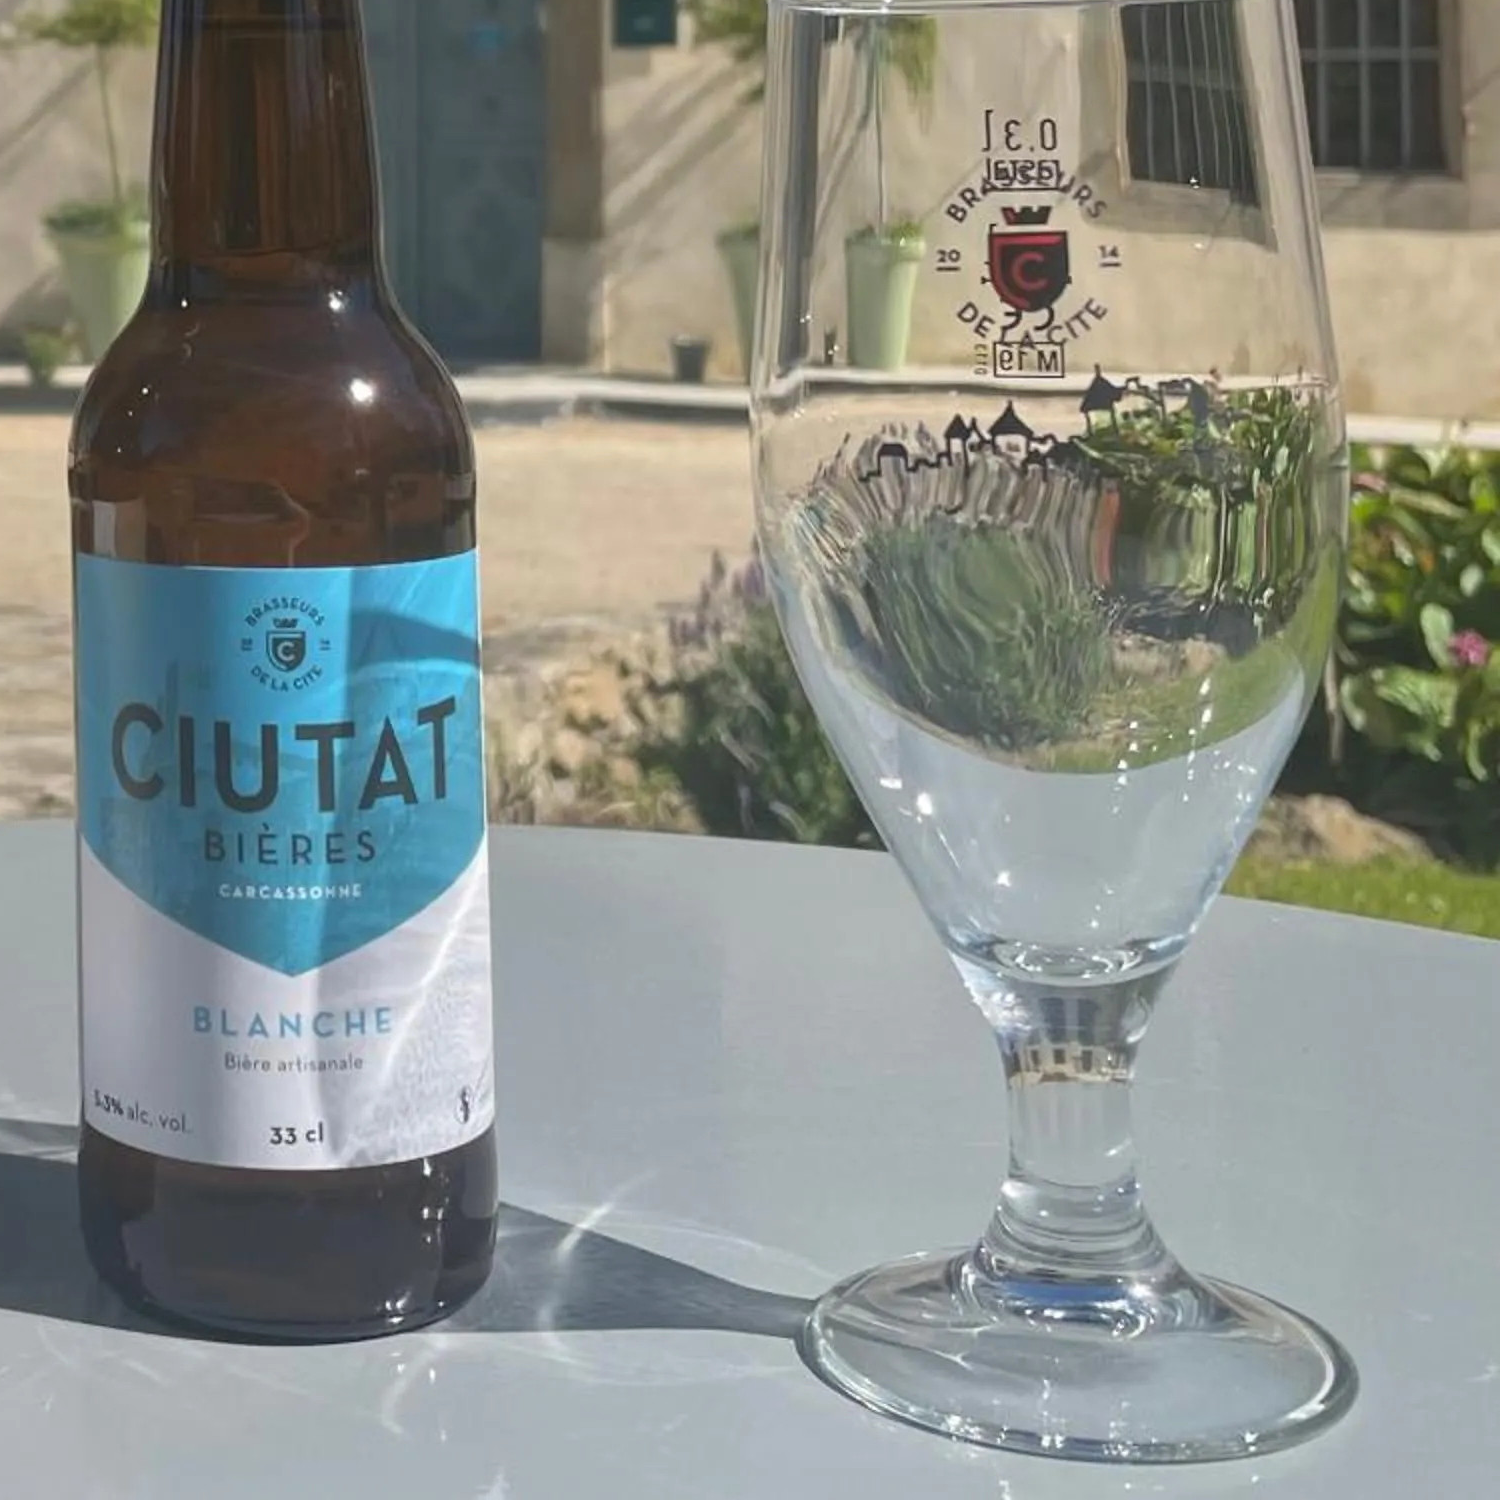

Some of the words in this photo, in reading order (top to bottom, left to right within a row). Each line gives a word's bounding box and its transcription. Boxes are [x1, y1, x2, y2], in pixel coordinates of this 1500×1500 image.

[937, 249, 961, 263] 20
[1100, 245, 1120, 260] 14
[957, 301, 995, 338] DE
[1047, 298, 1108, 345] CITE
[111, 696, 456, 815] CIUTAT
[205, 823, 377, 865] BIÈRES
[219, 882, 362, 901] CARCASSONNE
[193, 1005, 392, 1039] BLANCHE
[224, 1052, 271, 1073] Bière
[277, 1053, 363, 1074] artisanale
[158, 1112, 193, 1134] vol.
[269, 1126, 297, 1146] 33
[305, 1121, 324, 1143] cl
